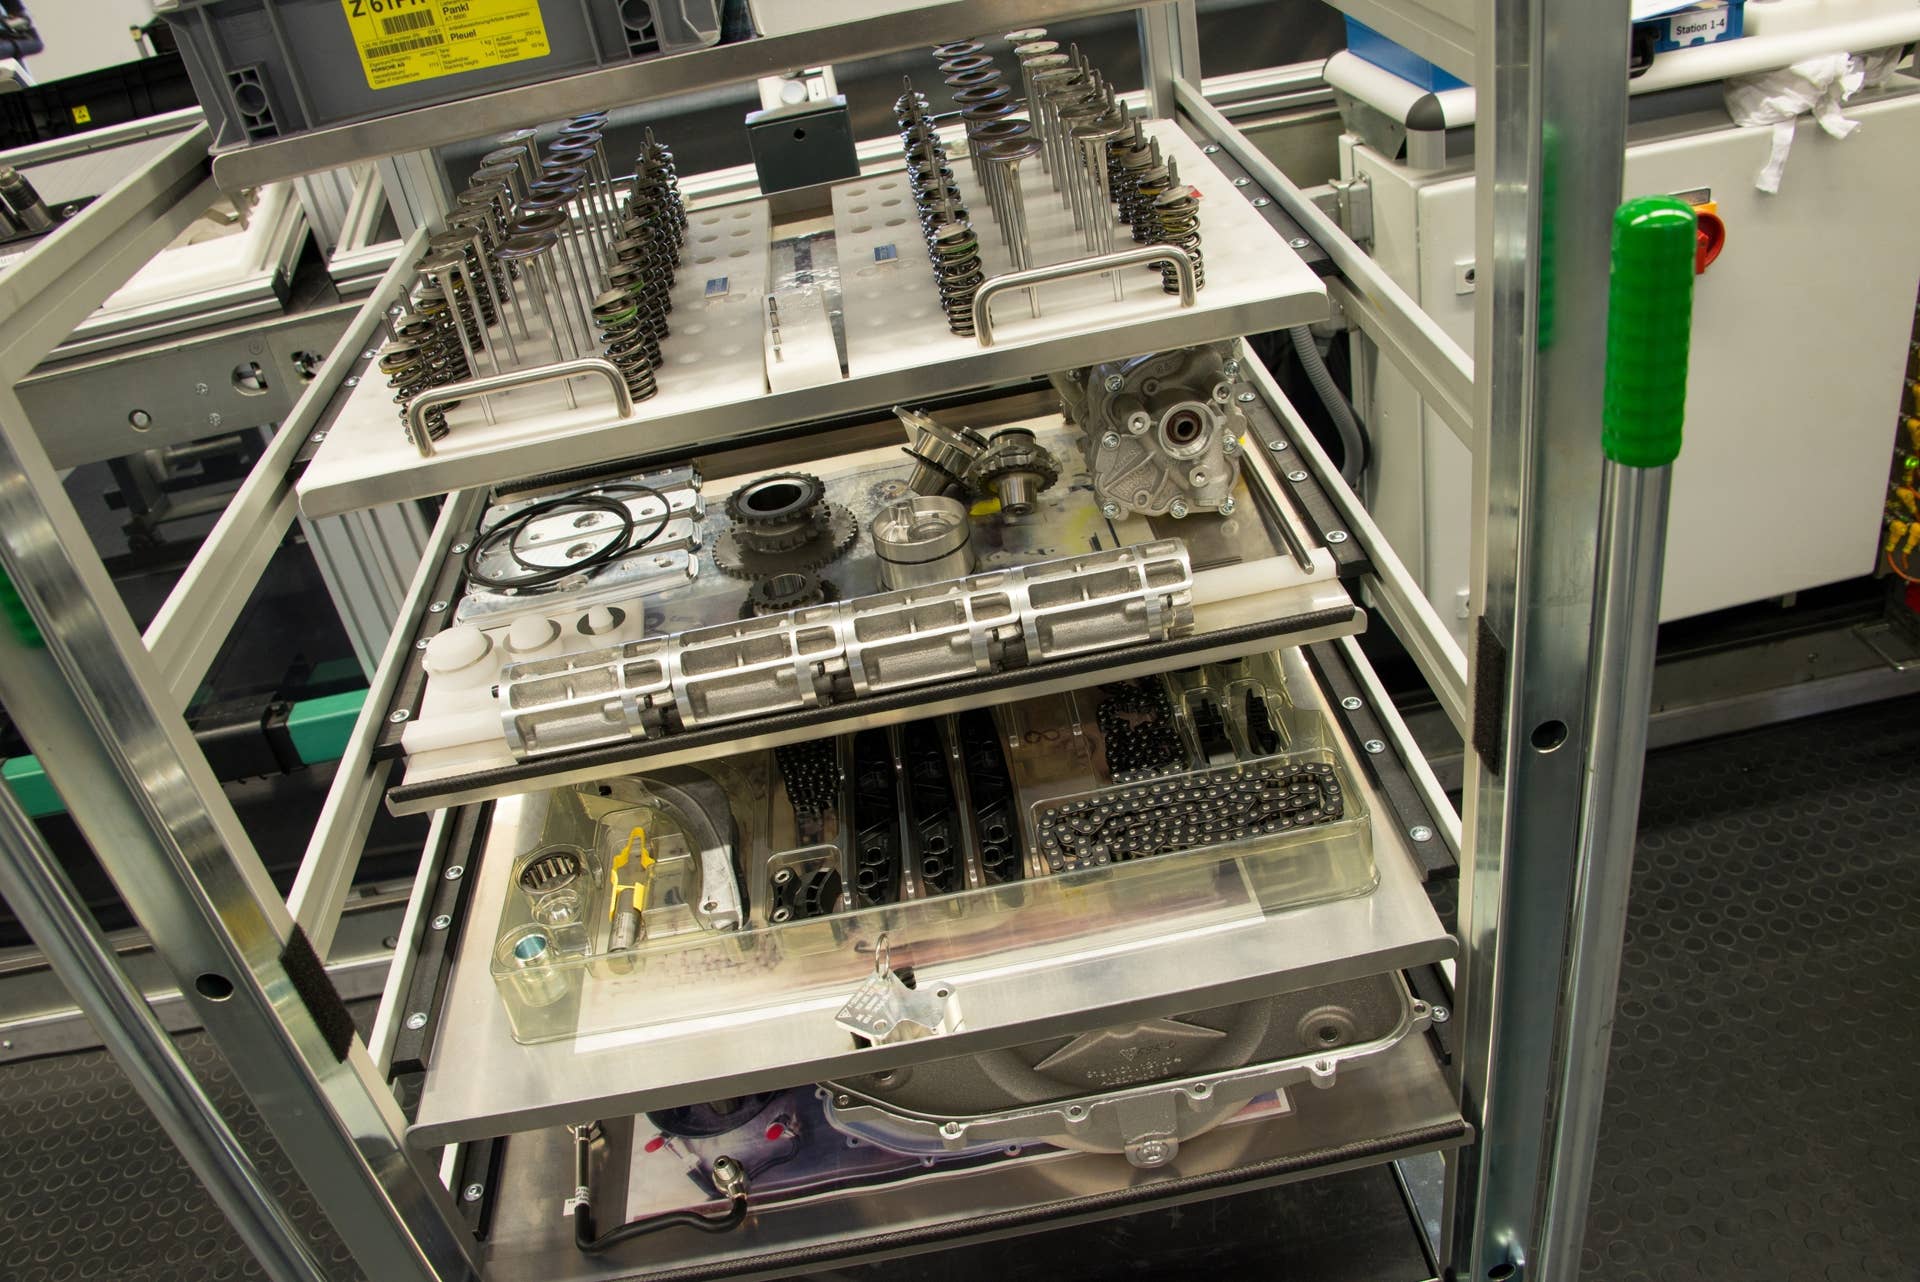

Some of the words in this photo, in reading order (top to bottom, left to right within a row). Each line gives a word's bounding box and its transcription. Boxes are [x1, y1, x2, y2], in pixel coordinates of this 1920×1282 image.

[442, 3, 469, 15] Pankl
[1676, 23, 1707, 35] Station
[1711, 18, 1725, 30] 1-4
[450, 29, 476, 41] Pleuel
